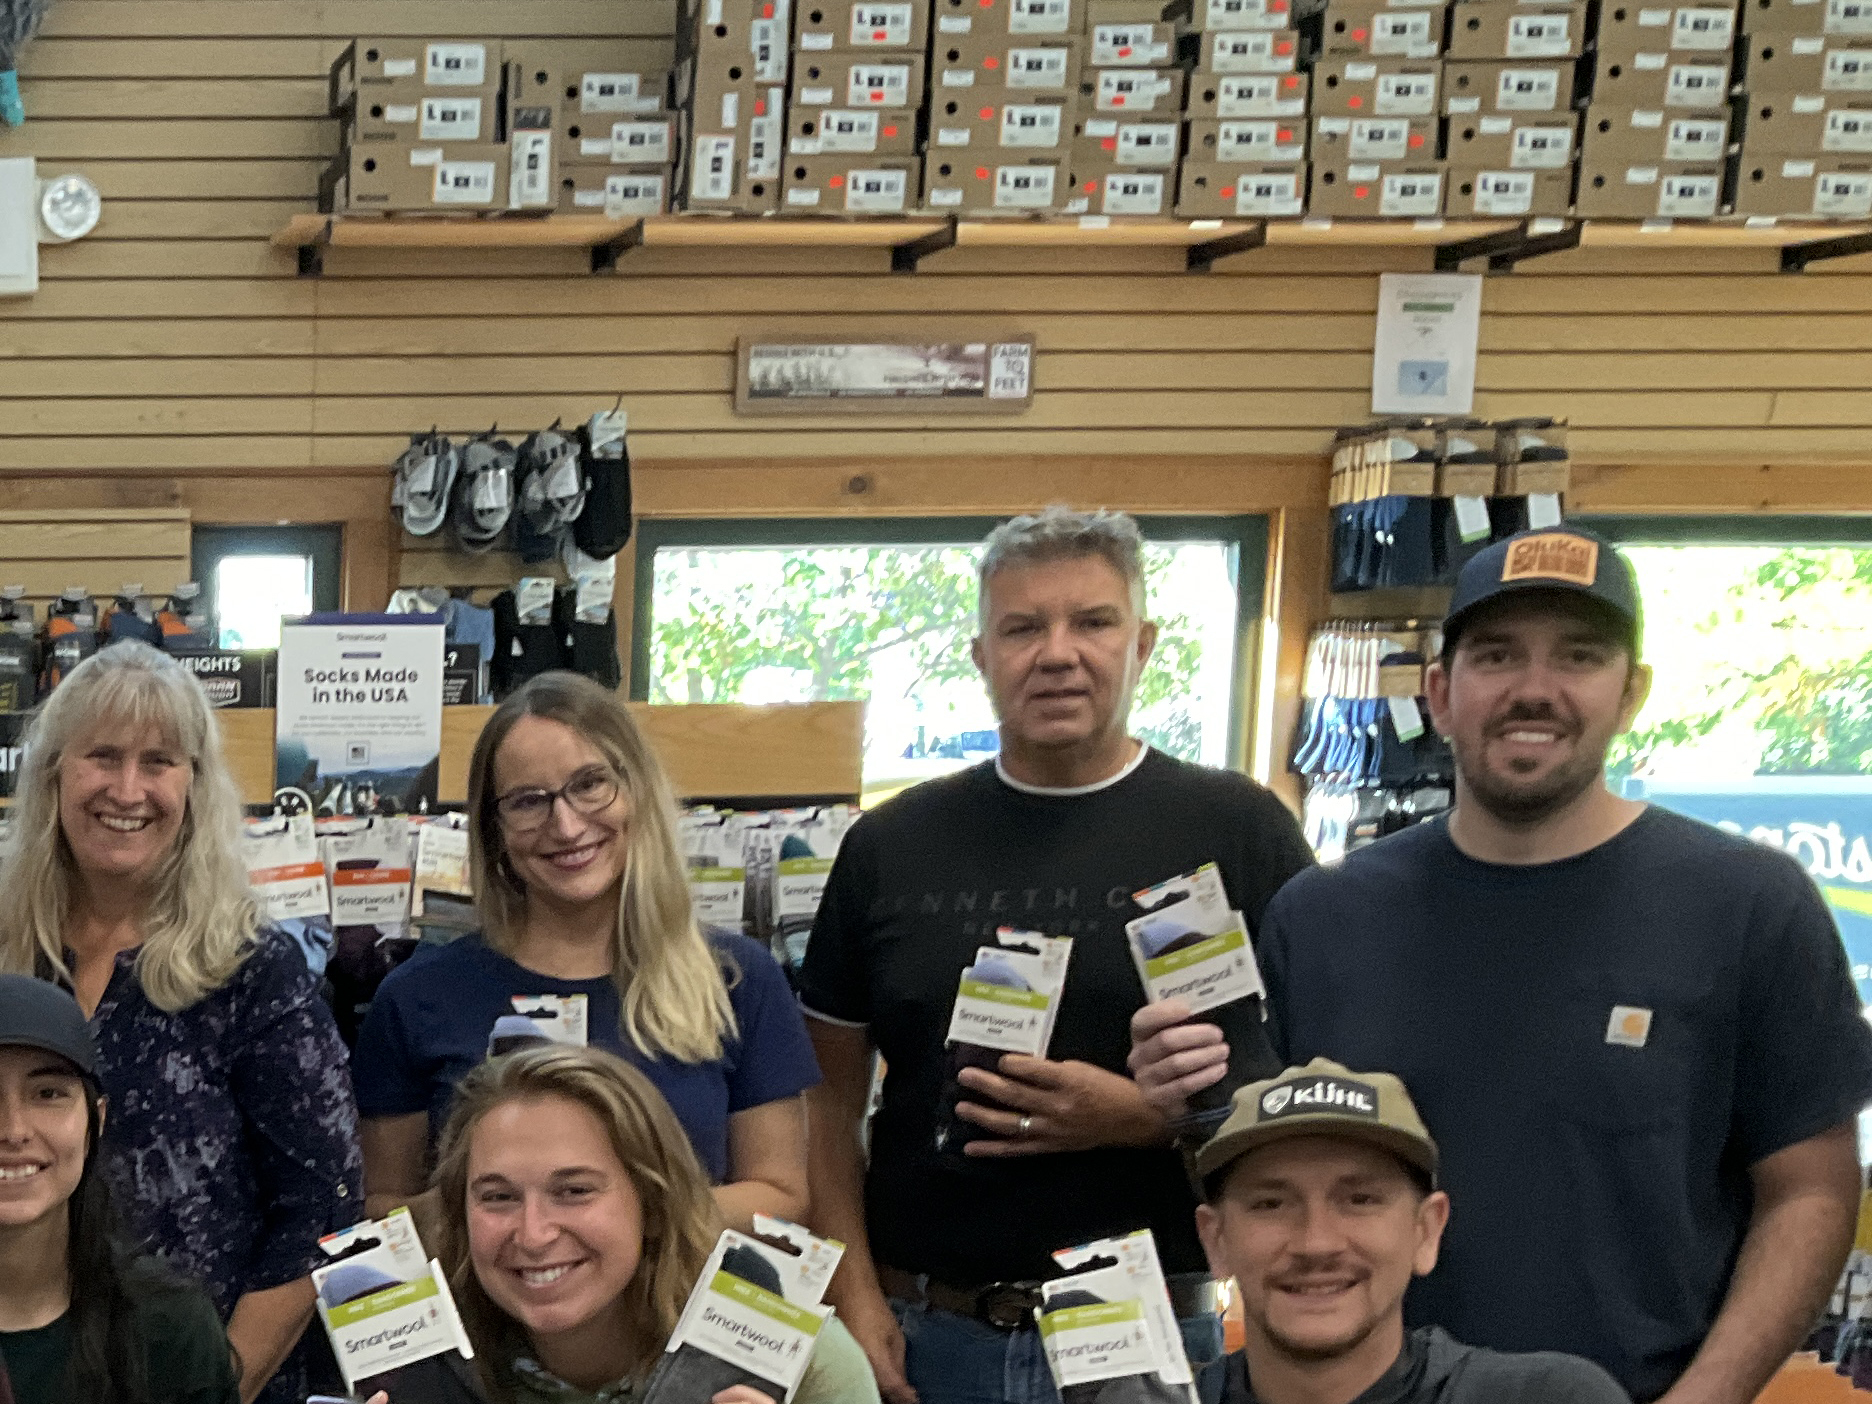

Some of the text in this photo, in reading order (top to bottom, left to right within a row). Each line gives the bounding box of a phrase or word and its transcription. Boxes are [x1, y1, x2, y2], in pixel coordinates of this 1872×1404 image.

[993, 377, 1026, 390] FEET
[304, 667, 419, 684] Socks Made
[312, 686, 410, 704] in the USA
[344, 1315, 428, 1354] Smartwool
[702, 1306, 786, 1354] Smartwool
